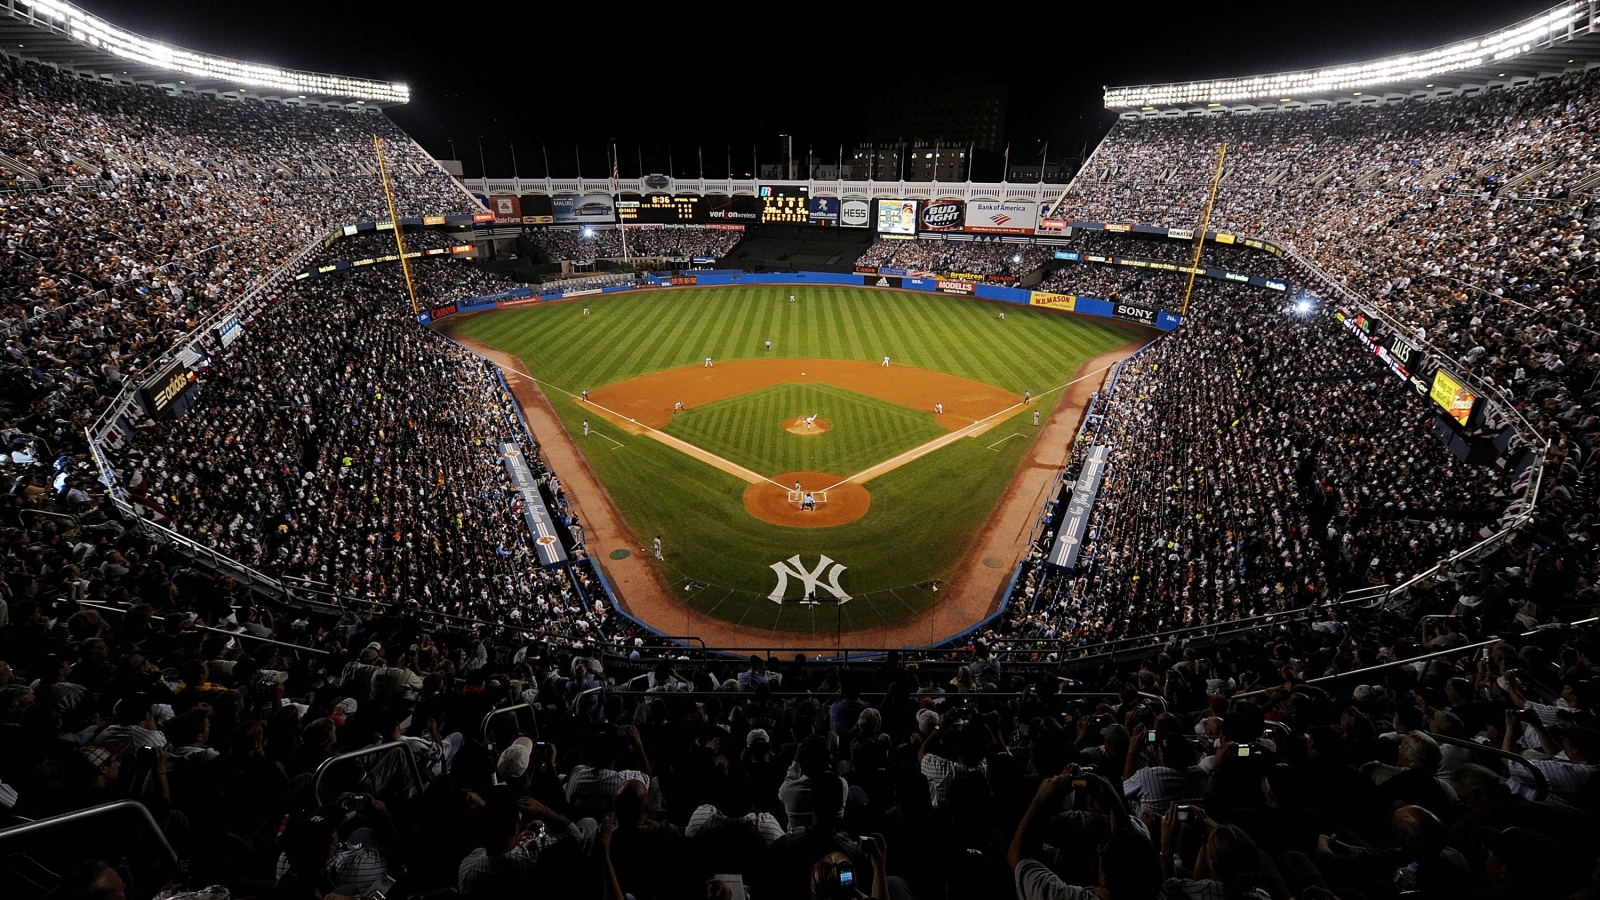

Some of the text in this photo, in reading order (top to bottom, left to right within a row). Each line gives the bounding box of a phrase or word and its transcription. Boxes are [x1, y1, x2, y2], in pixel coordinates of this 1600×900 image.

[710, 209, 737, 218] verizon
[843, 209, 866, 218] HESS
[929, 205, 957, 214] BUD
[925, 211, 960, 222] LIGHT
[1169, 230, 1192, 238] KOMATSU
[950, 272, 983, 280] Armitron
[939, 281, 972, 291] MODELL'S
[1047, 296, 1070, 304] MASON
[431, 305, 456, 320] Canon
[1118, 305, 1153, 319] SONY
[1390, 337, 1411, 362] ZALES
[165, 373, 187, 401] adidas
[767, 554, 853, 606] NY
